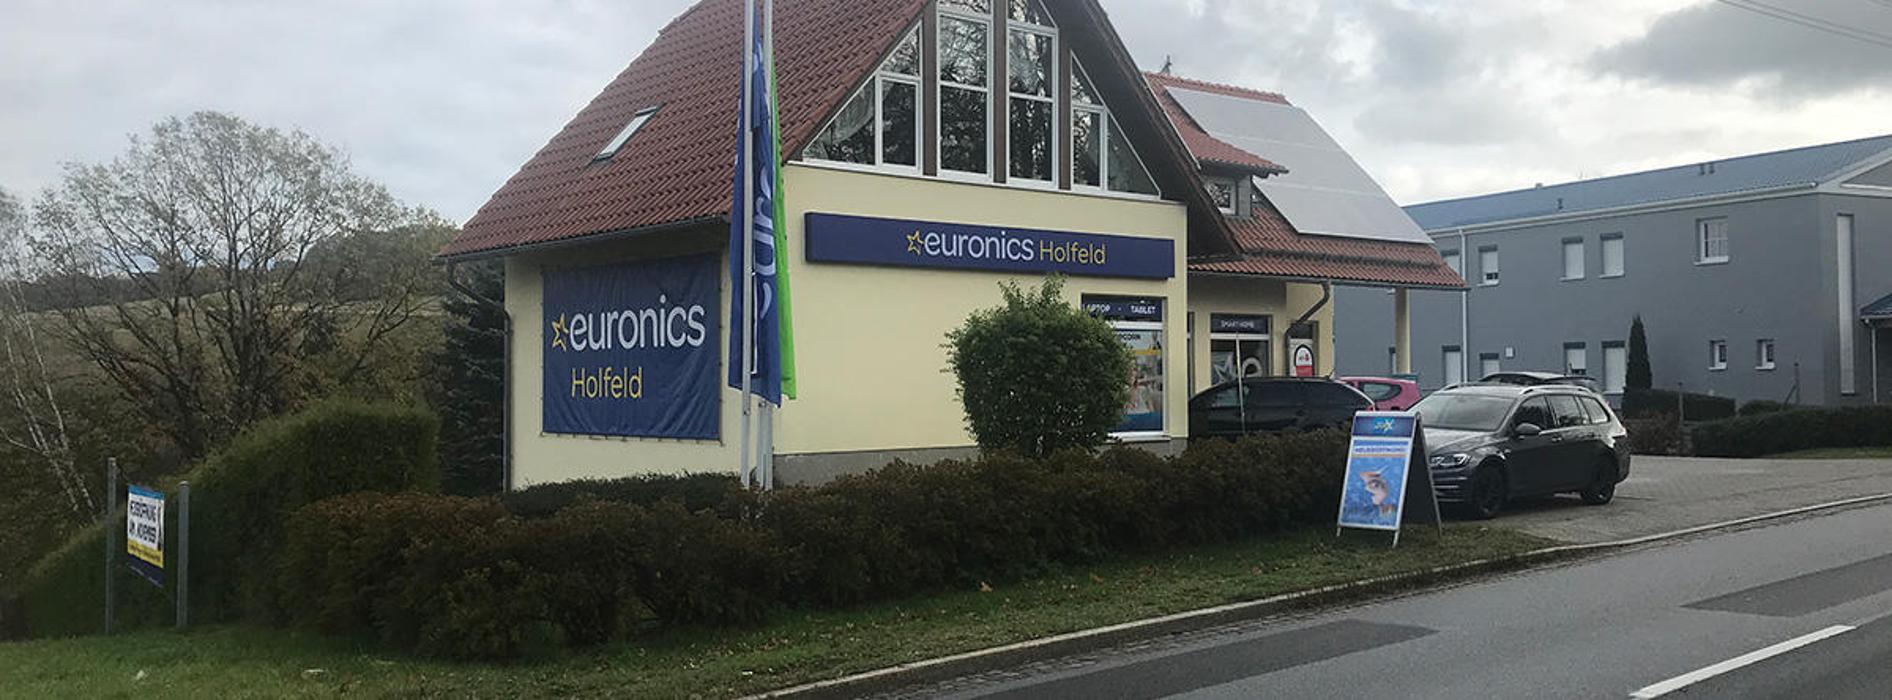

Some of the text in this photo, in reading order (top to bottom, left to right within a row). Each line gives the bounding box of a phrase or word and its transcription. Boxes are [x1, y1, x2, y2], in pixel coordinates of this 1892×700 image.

[924, 230, 1106, 265] euronics Holfeld
[570, 294, 706, 351] euronics
[1130, 304, 1156, 315] TABLET
[571, 366, 643, 399] Holfeld
